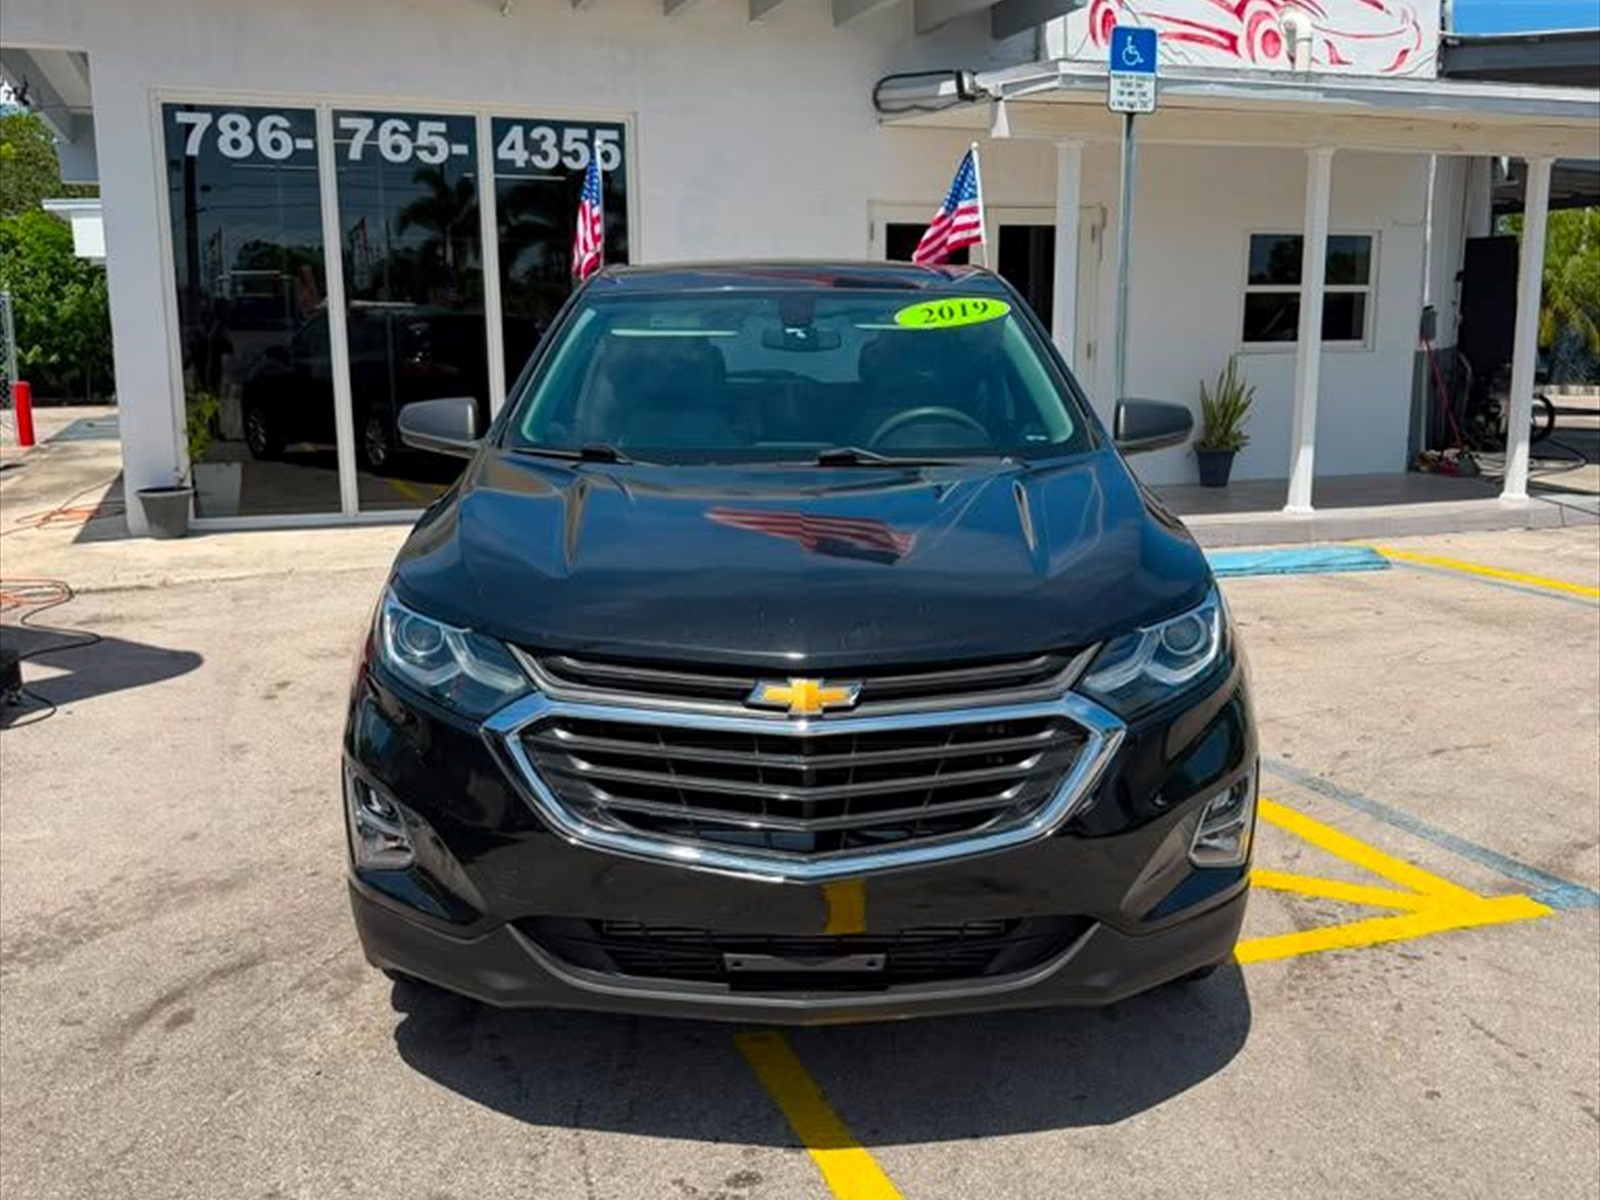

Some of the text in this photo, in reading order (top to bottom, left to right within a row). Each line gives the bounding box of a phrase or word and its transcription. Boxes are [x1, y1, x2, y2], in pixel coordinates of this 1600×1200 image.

[175, 112, 621, 171] 786- 765- 4355
[920, 301, 988, 324] 2019
